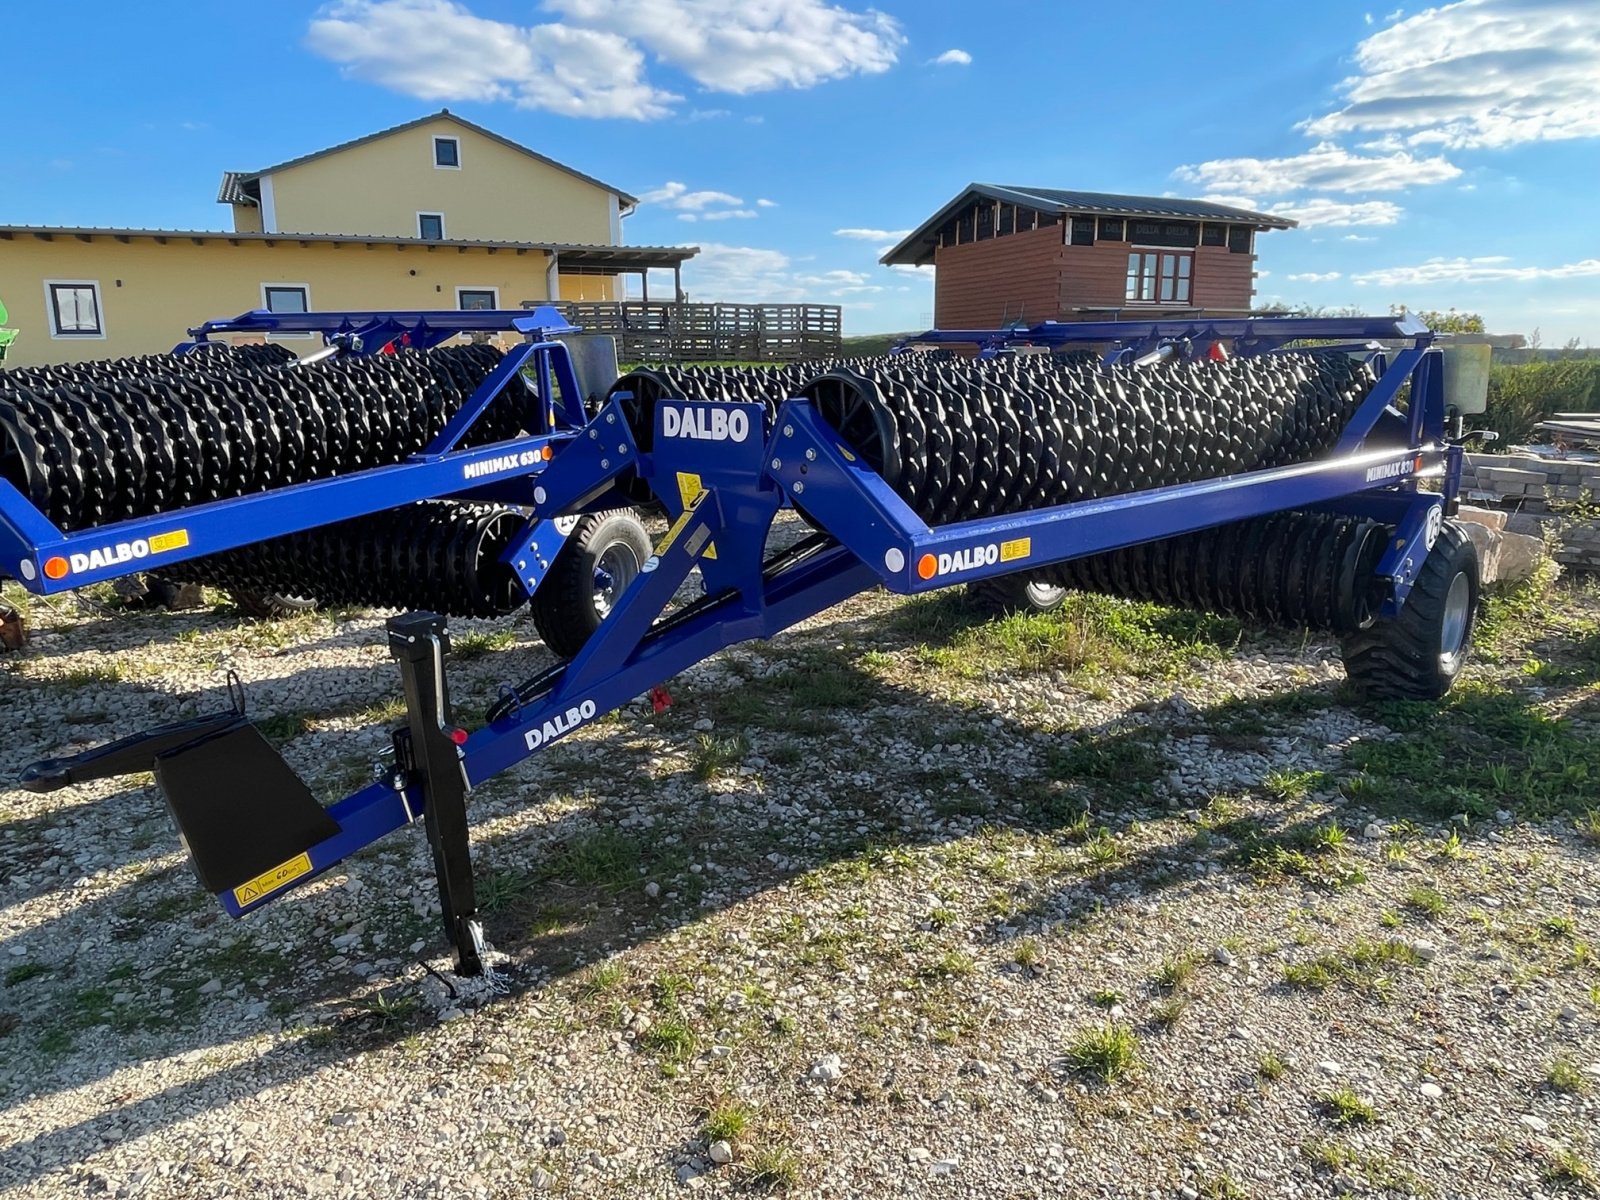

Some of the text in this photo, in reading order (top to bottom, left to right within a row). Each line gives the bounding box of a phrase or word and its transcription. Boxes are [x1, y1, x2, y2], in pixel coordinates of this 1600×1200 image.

[663, 406, 749, 442] DALBO
[463, 449, 542, 479] MINIMAX 630
[1366, 459, 1414, 482] MINIMAX 830
[1428, 511, 1440, 540] 25
[69, 539, 149, 574] DALBO
[938, 544, 998, 575] DALBO
[524, 699, 596, 751] DALBO
